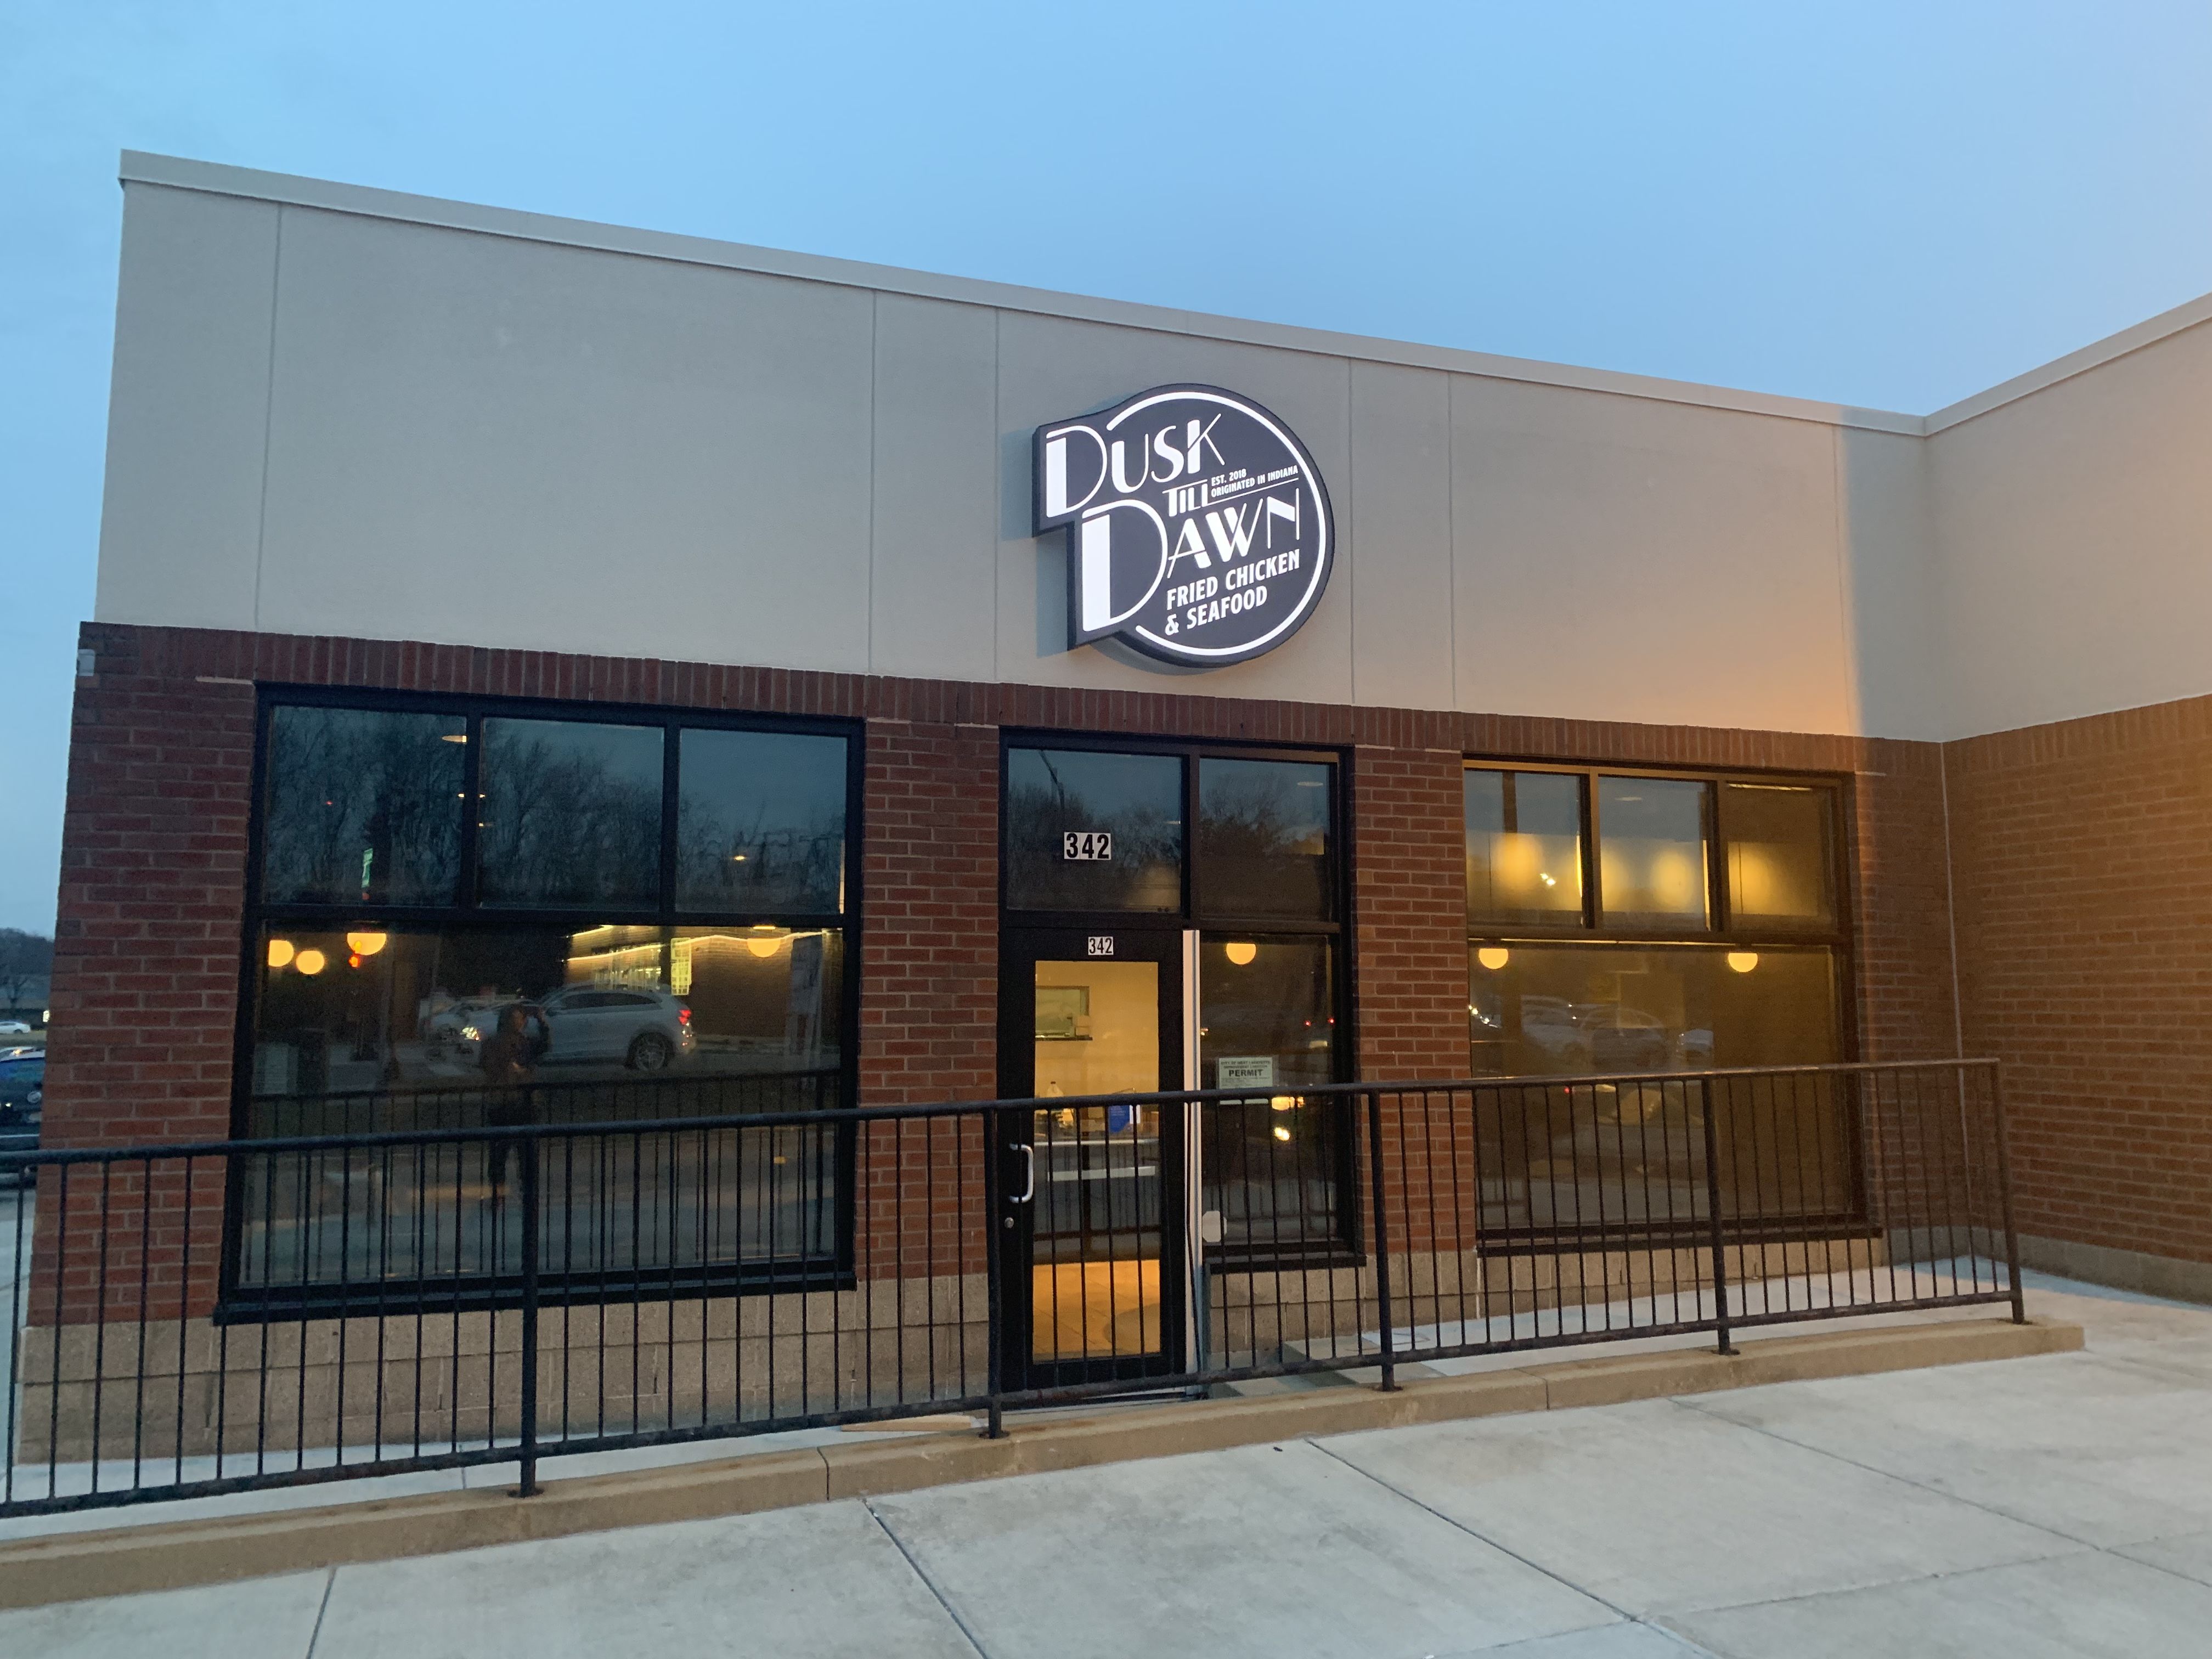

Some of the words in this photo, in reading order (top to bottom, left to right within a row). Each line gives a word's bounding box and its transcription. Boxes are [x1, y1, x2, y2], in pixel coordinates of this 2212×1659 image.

[1046, 413, 1225, 518] DUSK
[1211, 475, 1227, 487] EST.
[1229, 469, 1246, 482] 2018
[1211, 477, 1255, 498] ORIGINATED
[1257, 474, 1266, 484] IN
[1267, 465, 1299, 482] INDIANA
[1162, 479, 1208, 517] TILL
[1082, 488, 1300, 632] DAWN
[1166, 576, 1218, 611] FRIED
[1226, 549, 1300, 590] CHICKEN
[1165, 613, 1180, 636] &
[1187, 585, 1268, 629] SEAFOOD
[1066, 832, 1109, 859] 342
[1089, 937, 1113, 954] 342
[1229, 1069, 1263, 1077] PERMIT
